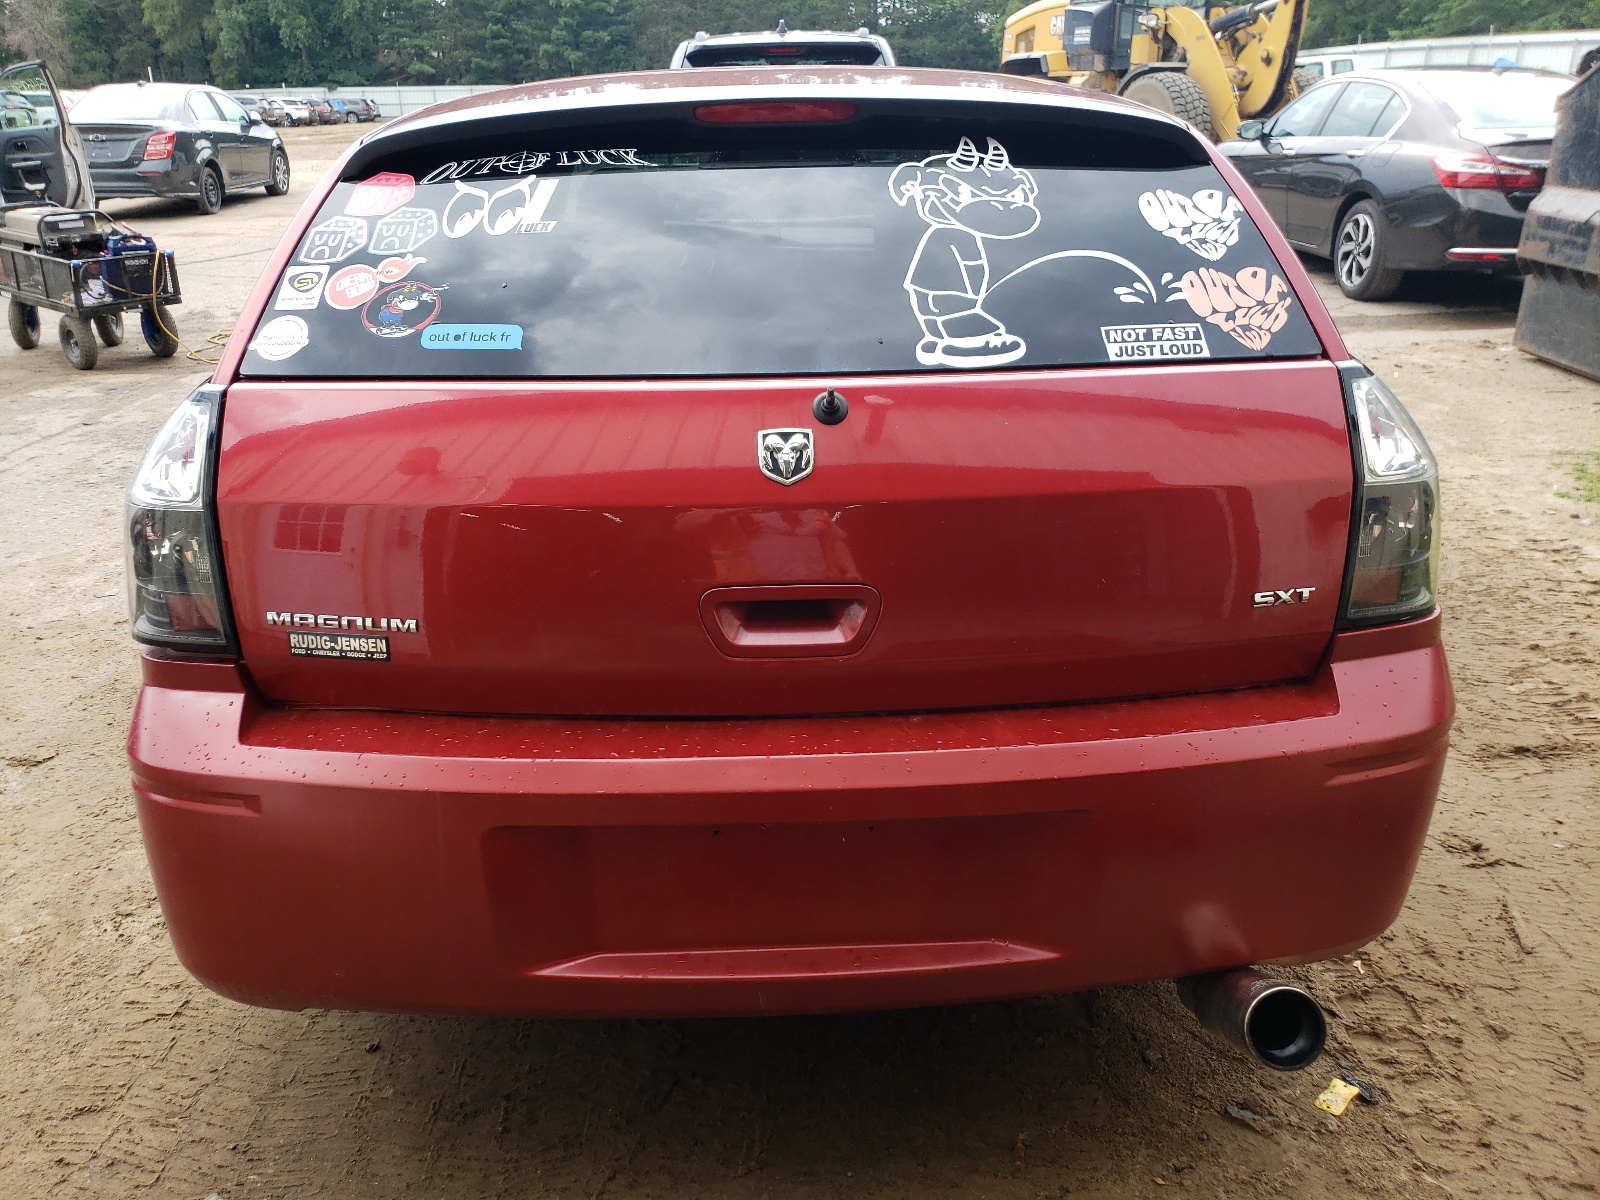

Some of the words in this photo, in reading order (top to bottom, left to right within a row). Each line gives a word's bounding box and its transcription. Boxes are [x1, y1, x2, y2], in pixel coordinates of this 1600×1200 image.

[420, 155, 505, 185] OUT
[556, 149, 658, 167] LUCK
[1138, 188, 1214, 232] OUT
[1192, 189, 1244, 222] OF
[517, 222, 552, 233] LUCK
[1162, 217, 1242, 246] LUCK
[1181, 266, 1257, 317] OUT
[1235, 266, 1289, 304] OF
[1205, 296, 1292, 333] LUCK
[429, 332, 450, 342] out
[453, 331, 468, 342] of
[469, 331, 497, 342] luck
[500, 331, 512, 343] fr
[1109, 328, 1147, 343] NOT
[1152, 327, 1197, 341] FAST
[1114, 344, 1157, 358] JUST
[1160, 343, 1204, 356] LOUD
[1253, 587, 1316, 608] SXT
[266, 611, 417, 633] MAGNUM
[289, 633, 387, 653] RUDIG-JENSEN
